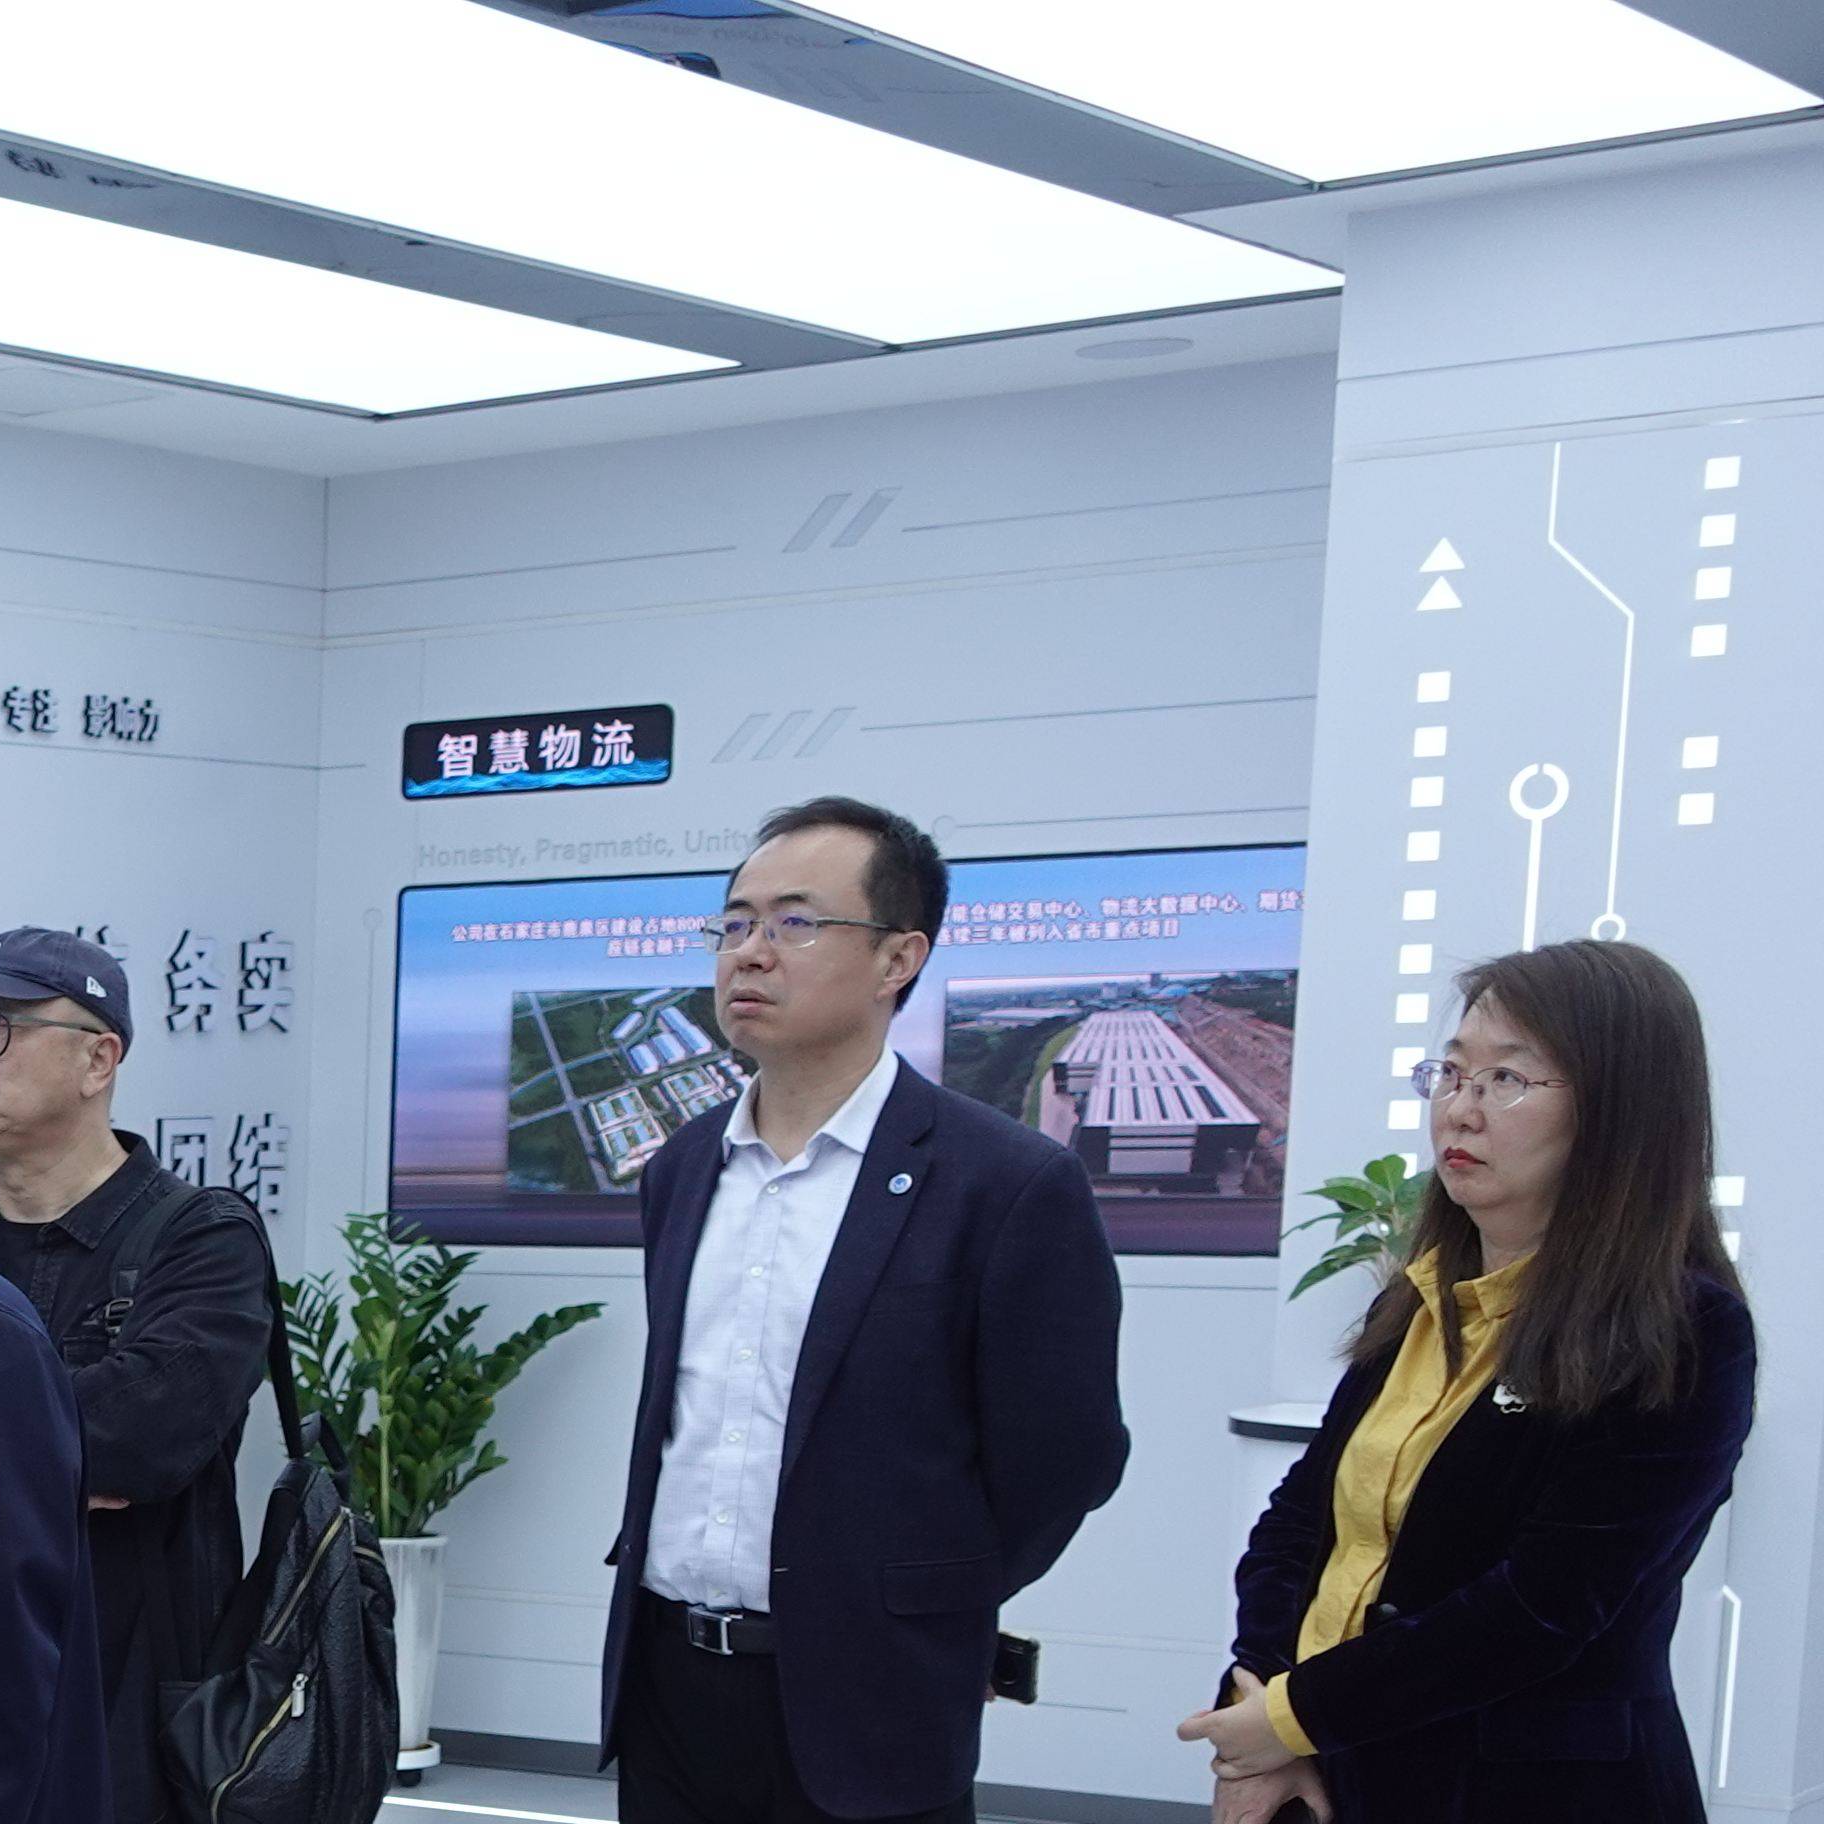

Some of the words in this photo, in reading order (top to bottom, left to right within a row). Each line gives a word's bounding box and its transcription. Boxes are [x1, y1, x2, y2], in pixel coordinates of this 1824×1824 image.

[438, 720, 635, 778] 智慧物流
[417, 842, 528, 867] Honesty,
[535, 834, 675, 864] Pragmatic,
